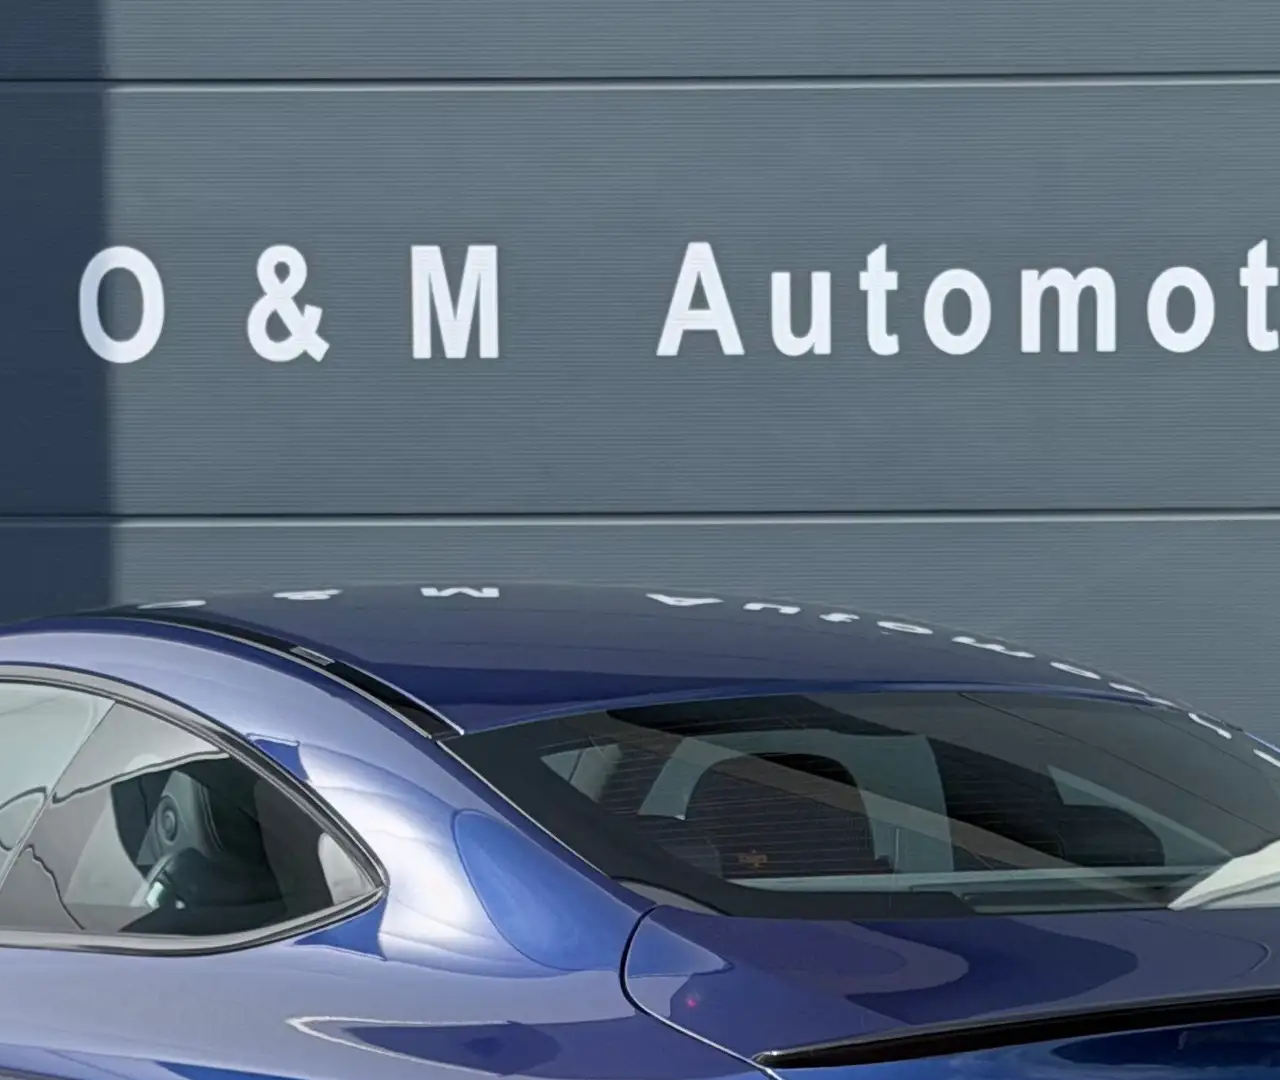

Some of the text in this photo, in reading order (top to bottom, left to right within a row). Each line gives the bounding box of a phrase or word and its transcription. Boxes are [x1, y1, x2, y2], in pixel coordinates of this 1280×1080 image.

[79, 245, 165, 364] O
[247, 244, 330, 363] &
[411, 244, 499, 360] M
